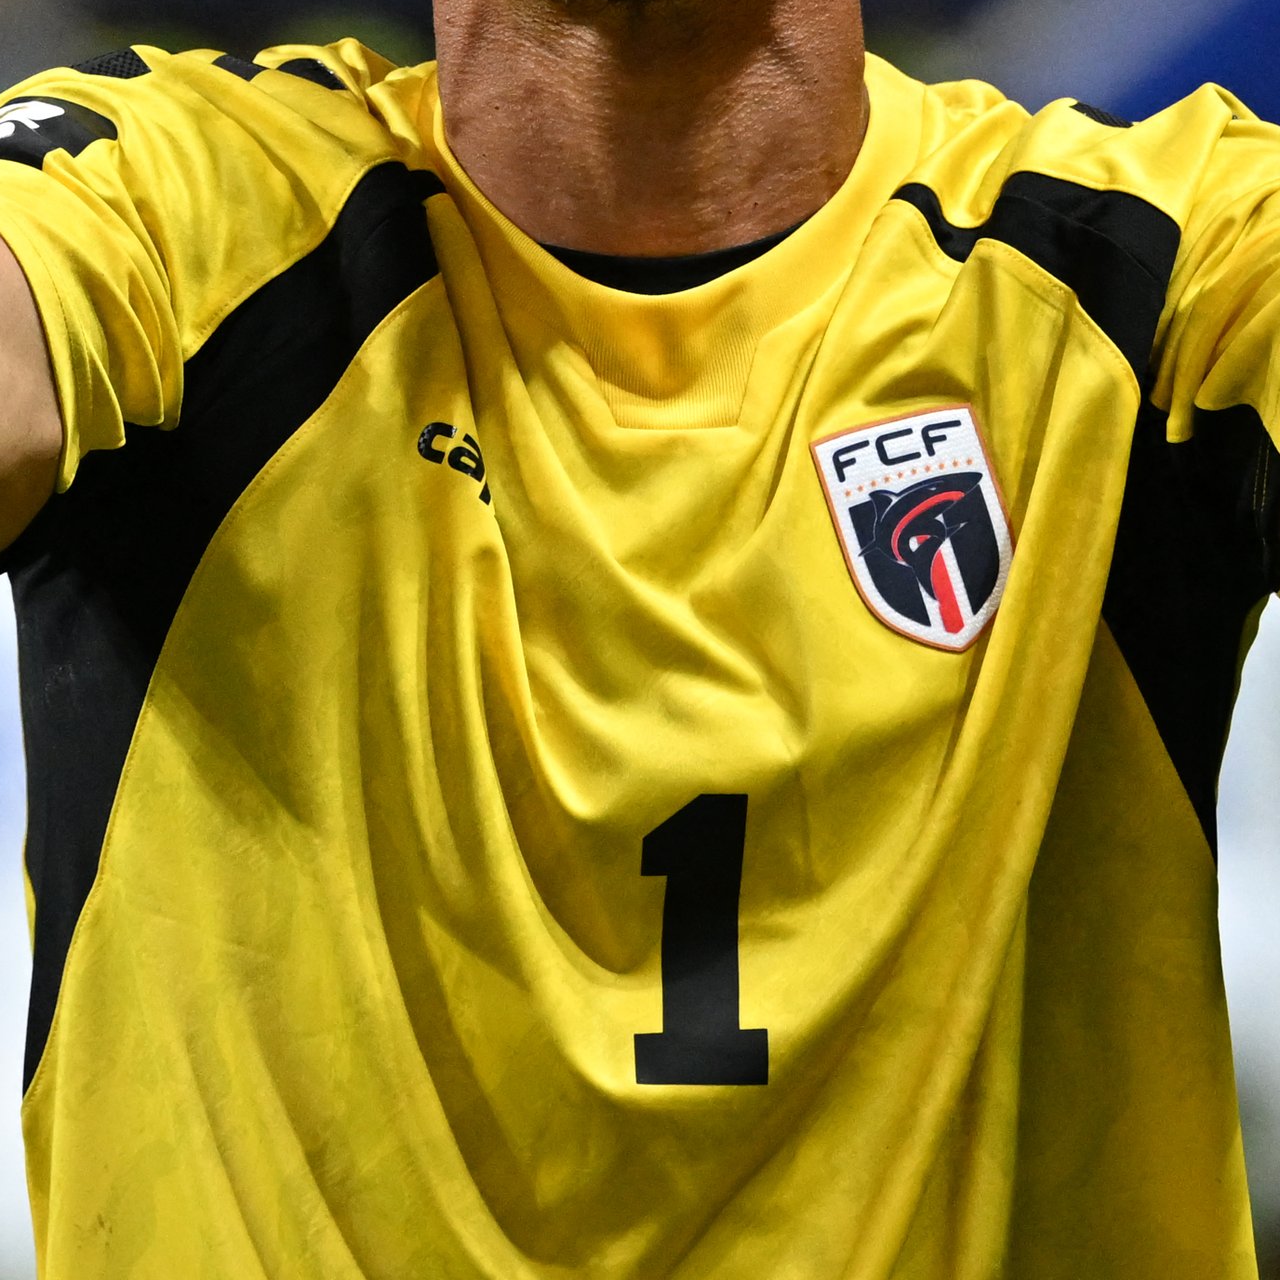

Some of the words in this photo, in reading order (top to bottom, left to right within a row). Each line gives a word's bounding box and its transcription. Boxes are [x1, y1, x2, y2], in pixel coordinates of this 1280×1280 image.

[417, 421, 491, 506] ca
[832, 419, 962, 483] FCF
[634, 793, 769, 1085] 1
